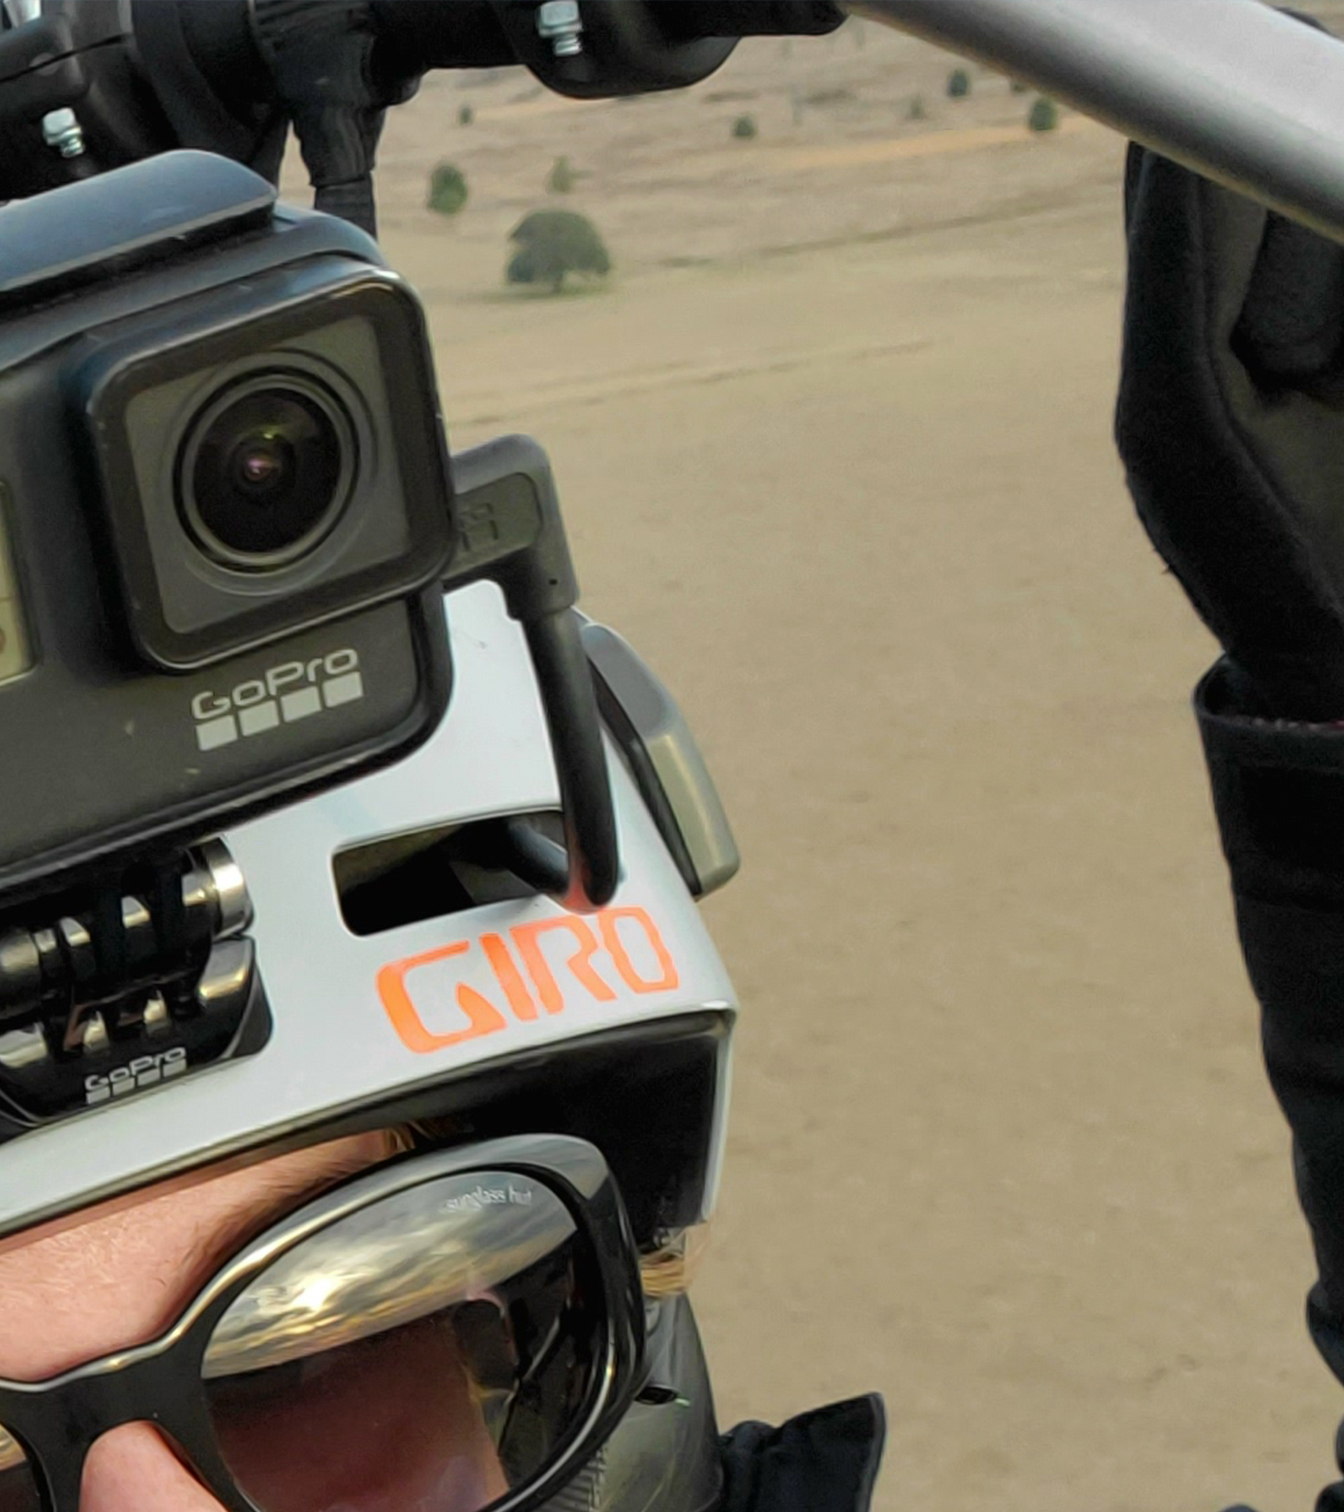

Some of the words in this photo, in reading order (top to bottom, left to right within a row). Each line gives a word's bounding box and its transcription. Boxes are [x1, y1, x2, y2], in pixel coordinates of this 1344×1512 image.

[190, 648, 359, 720] GoPro
[375, 905, 680, 1055] GIRO
[84, 1046, 187, 1091] GoPro
